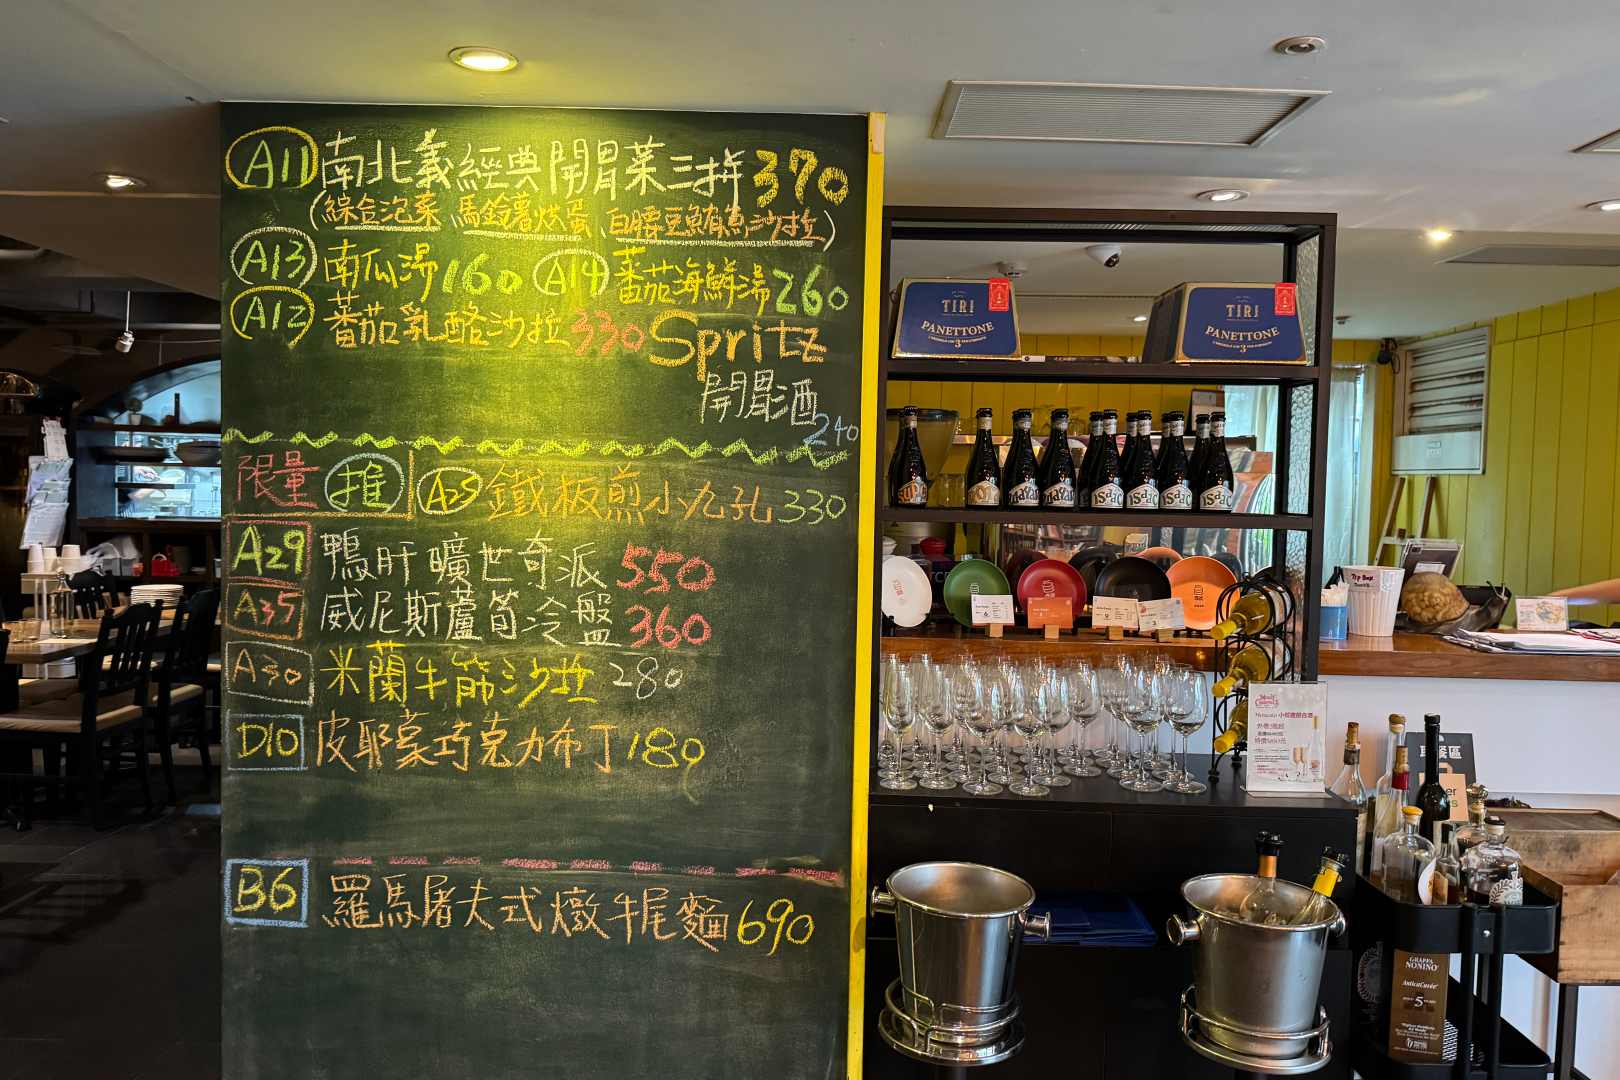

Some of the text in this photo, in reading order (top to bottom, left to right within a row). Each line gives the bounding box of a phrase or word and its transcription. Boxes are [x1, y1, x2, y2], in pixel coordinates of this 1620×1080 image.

[244, 139, 309, 189] A11
[752, 147, 850, 207] 370
[239, 239, 307, 281] A13
[324, 238, 439, 303] 南瓜湯
[441, 252, 524, 297] 160
[544, 255, 605, 298] A14
[772, 264, 850, 317] 260
[241, 295, 307, 331] A12
[570, 305, 647, 357] 330
[921, 320, 995, 336] PANETTONE
[941, 299, 975, 313] TIRI
[1225, 304, 1260, 318] TIRI
[1205, 325, 1280, 341] PANETTONE
[700, 369, 818, 426] 開胃酒
[803, 413, 859, 446] 240
[238, 450, 848, 529] 限量 推 A25 鐵板煎小九孔 330
[231, 525, 305, 576] A29
[615, 542, 717, 595] 550
[233, 584, 713, 649] A35 威尼斯蘆筍冷盤 360
[608, 656, 684, 700] 280
[236, 721, 300, 759] D10
[627, 726, 706, 770] 180
[232, 865, 298, 914] B6
[736, 898, 816, 957] 690
[1405, 961, 1438, 971] NONINO
[1414, 996, 1425, 1007] 5
